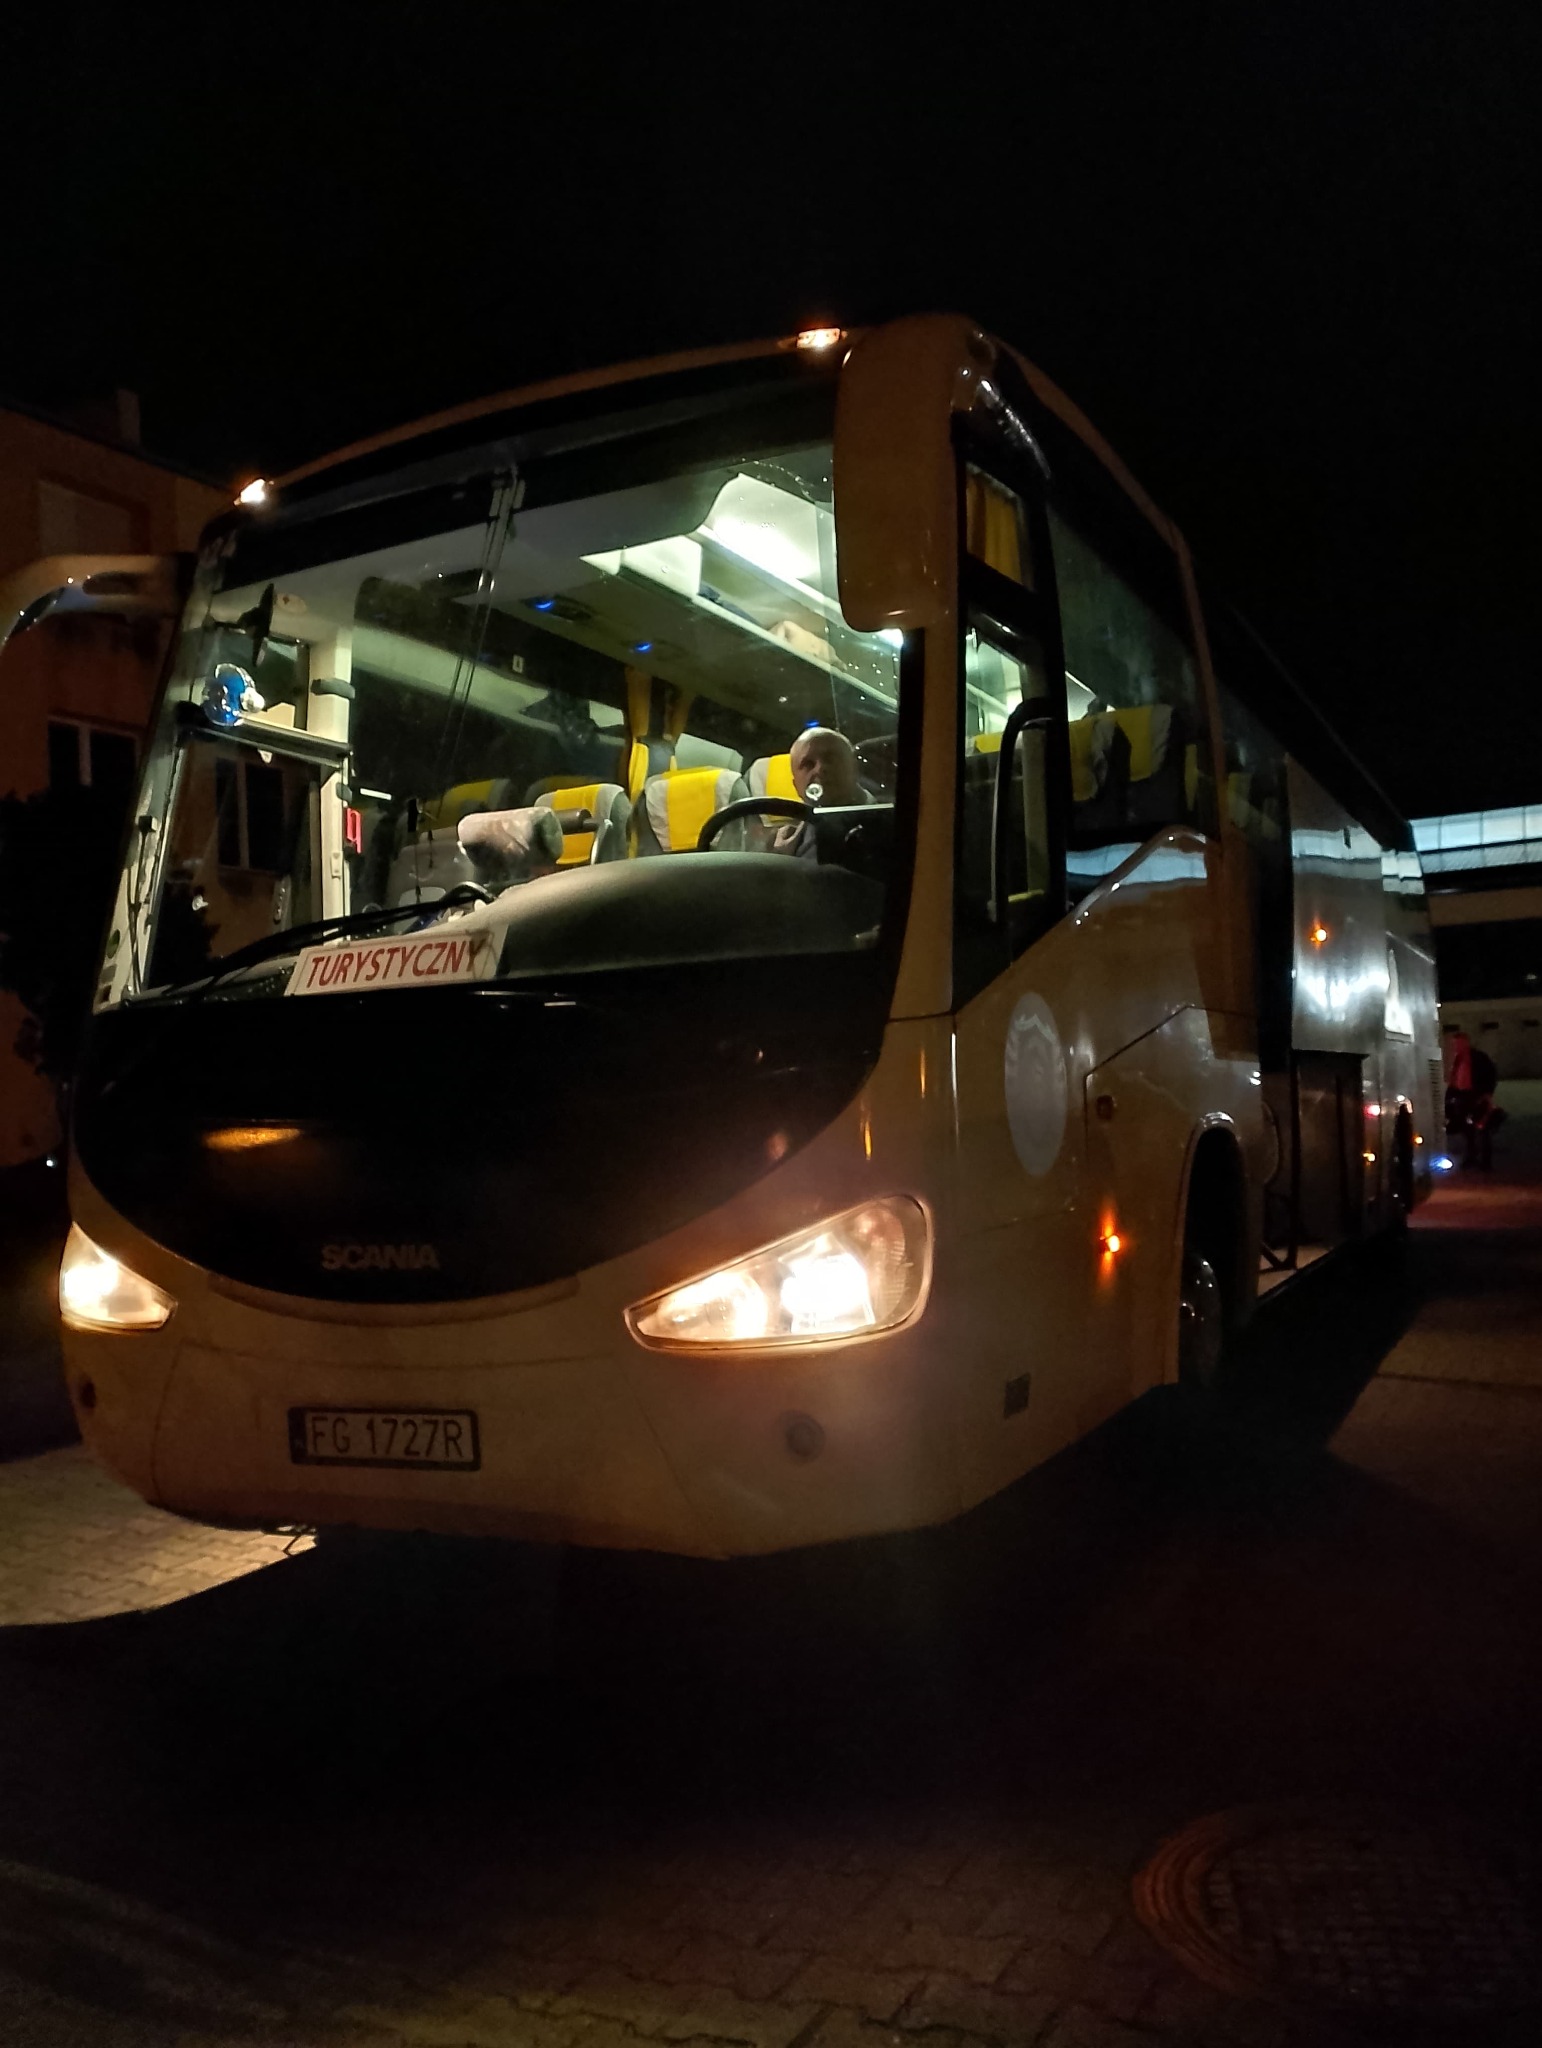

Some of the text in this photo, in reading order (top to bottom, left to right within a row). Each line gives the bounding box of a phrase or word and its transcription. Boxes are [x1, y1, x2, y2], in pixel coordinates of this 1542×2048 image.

[306, 939, 487, 988] TURYSTYCZNY
[321, 1244, 440, 1270] SCANIA
[311, 1416, 464, 1457] FG 1727R
